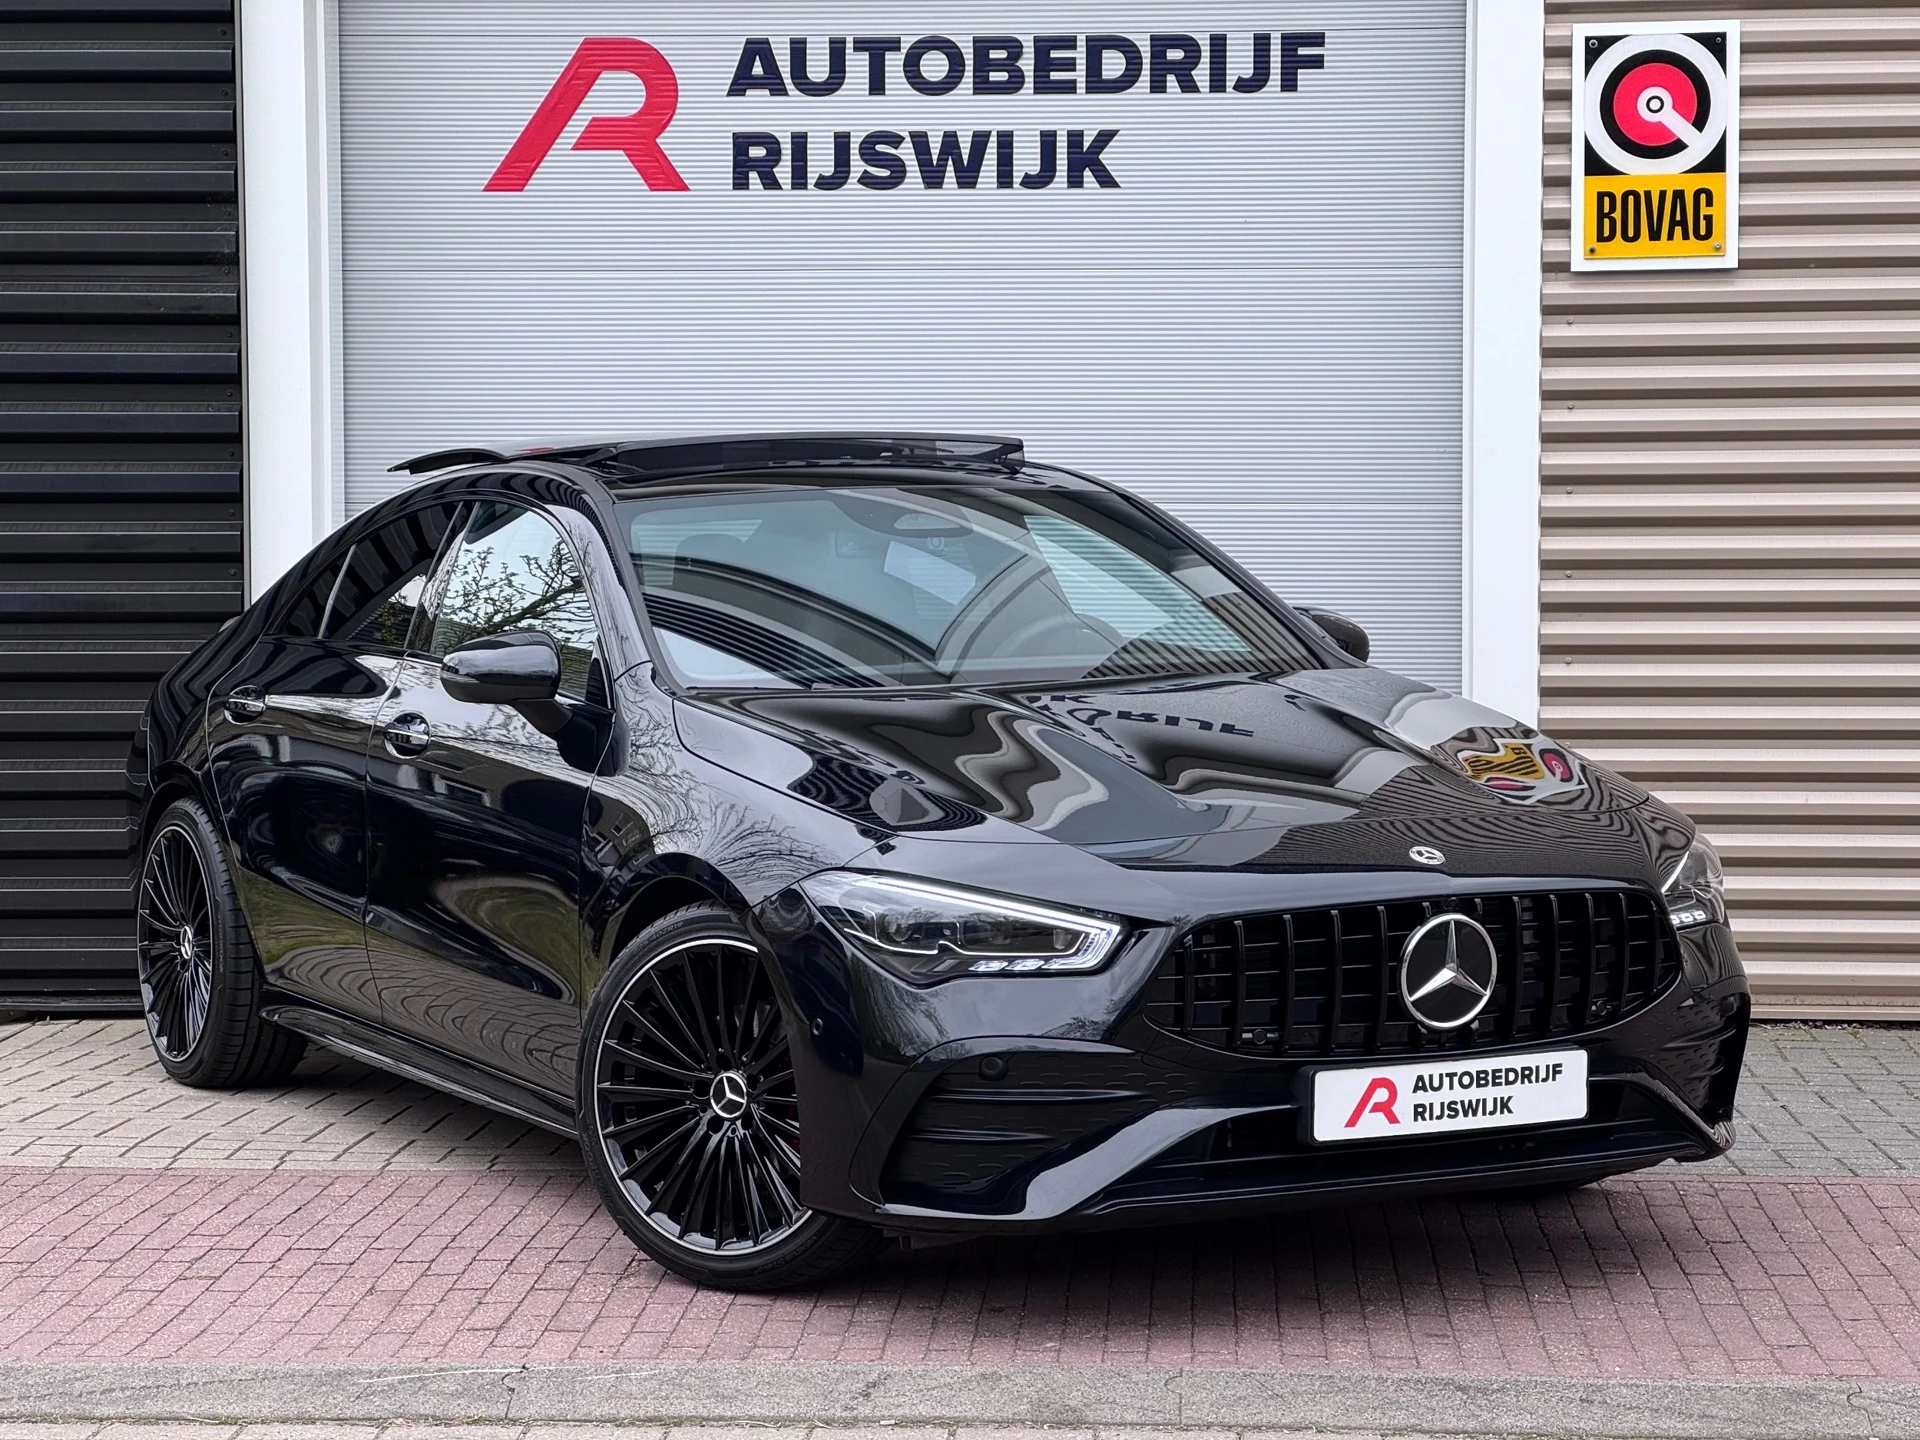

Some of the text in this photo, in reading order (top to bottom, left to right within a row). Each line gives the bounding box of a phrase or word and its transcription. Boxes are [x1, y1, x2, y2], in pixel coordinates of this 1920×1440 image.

[727, 32, 1325, 97] AUTOBEDRIJF
[733, 130, 1120, 190] RIJSWIJK
[1597, 188, 1713, 243] BOVAG
[1412, 1063, 1563, 1093] AUTOBEDRIJF
[1413, 1096, 1514, 1122] RIJSWIJK
